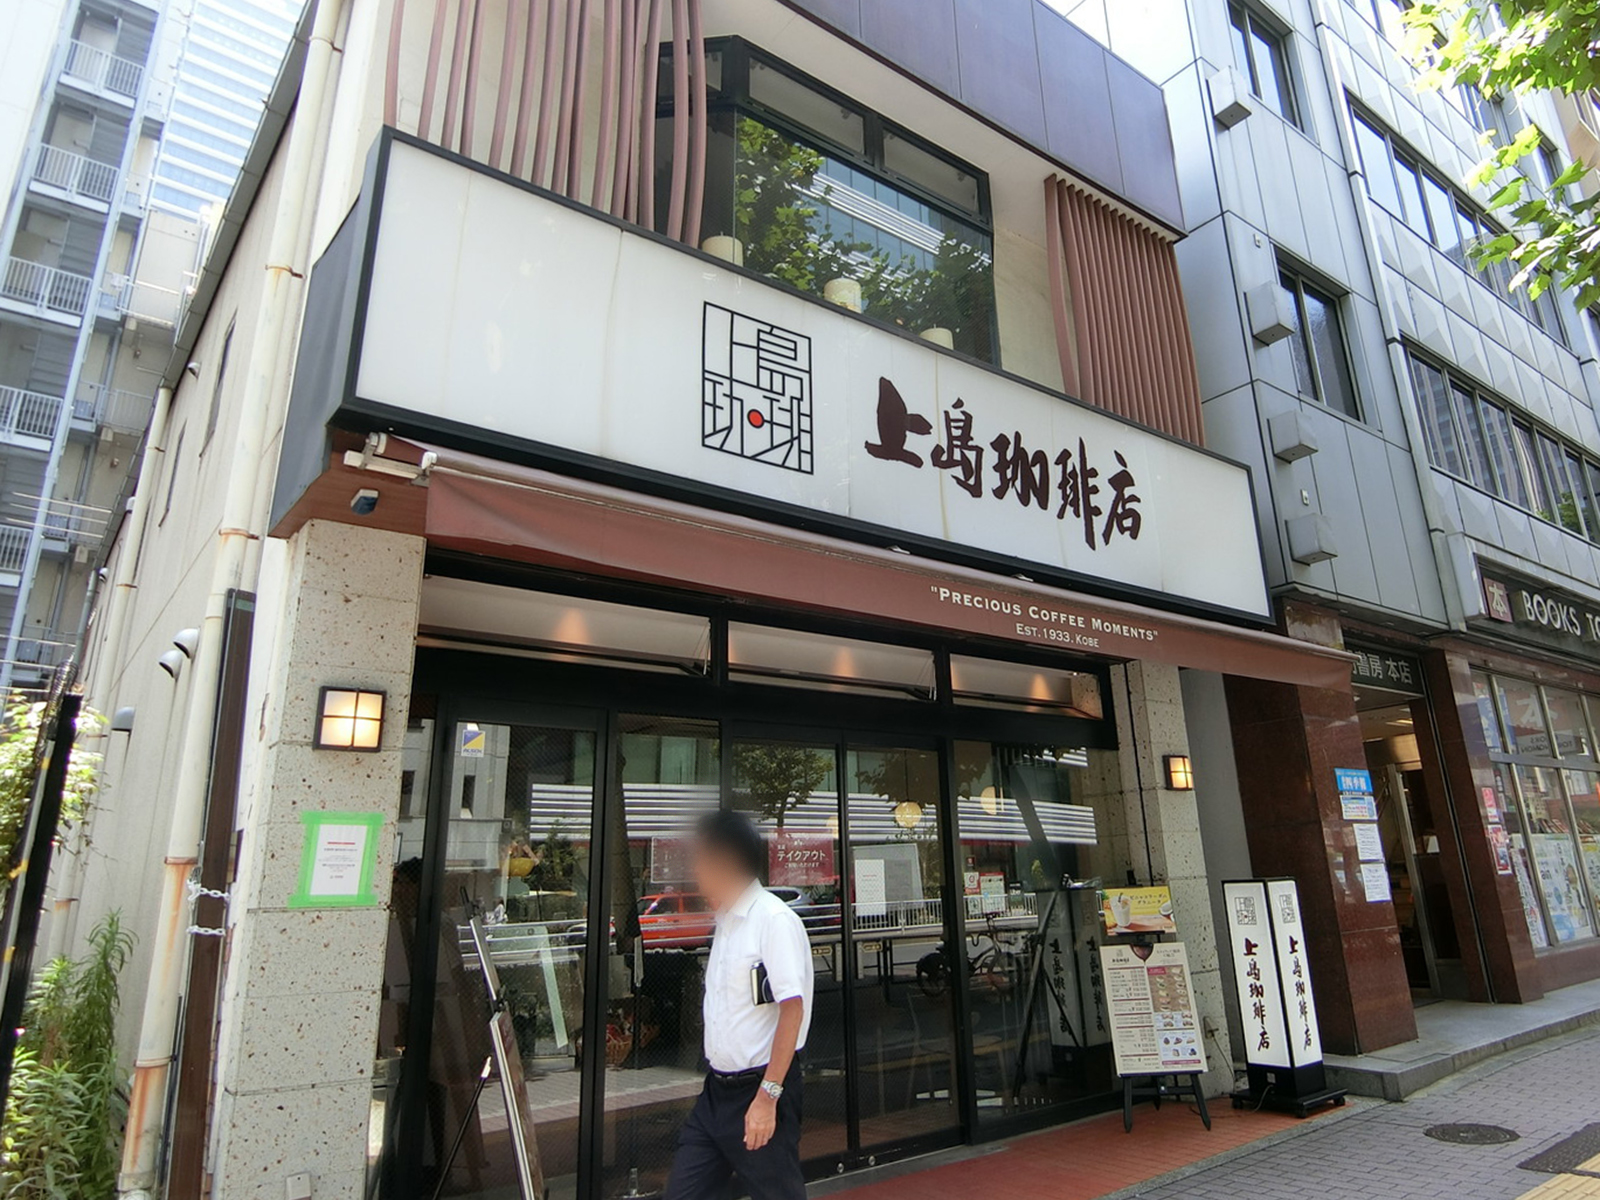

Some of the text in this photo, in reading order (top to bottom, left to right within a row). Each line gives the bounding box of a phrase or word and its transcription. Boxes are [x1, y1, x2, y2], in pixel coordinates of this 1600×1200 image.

[864, 376, 1142, 550] 上島珈琲店
[1028, 605, 1085, 629] COFFEE
[1488, 583, 1508, 618] 本
[1521, 589, 1581, 637] BOOKS
[1385, 657, 1413, 685] 本店
[777, 850, 826, 861] テイクアウト
[1242, 937, 1270, 1052] 上島珈琲店
[1288, 935, 1313, 1051] 上島珈琲店
